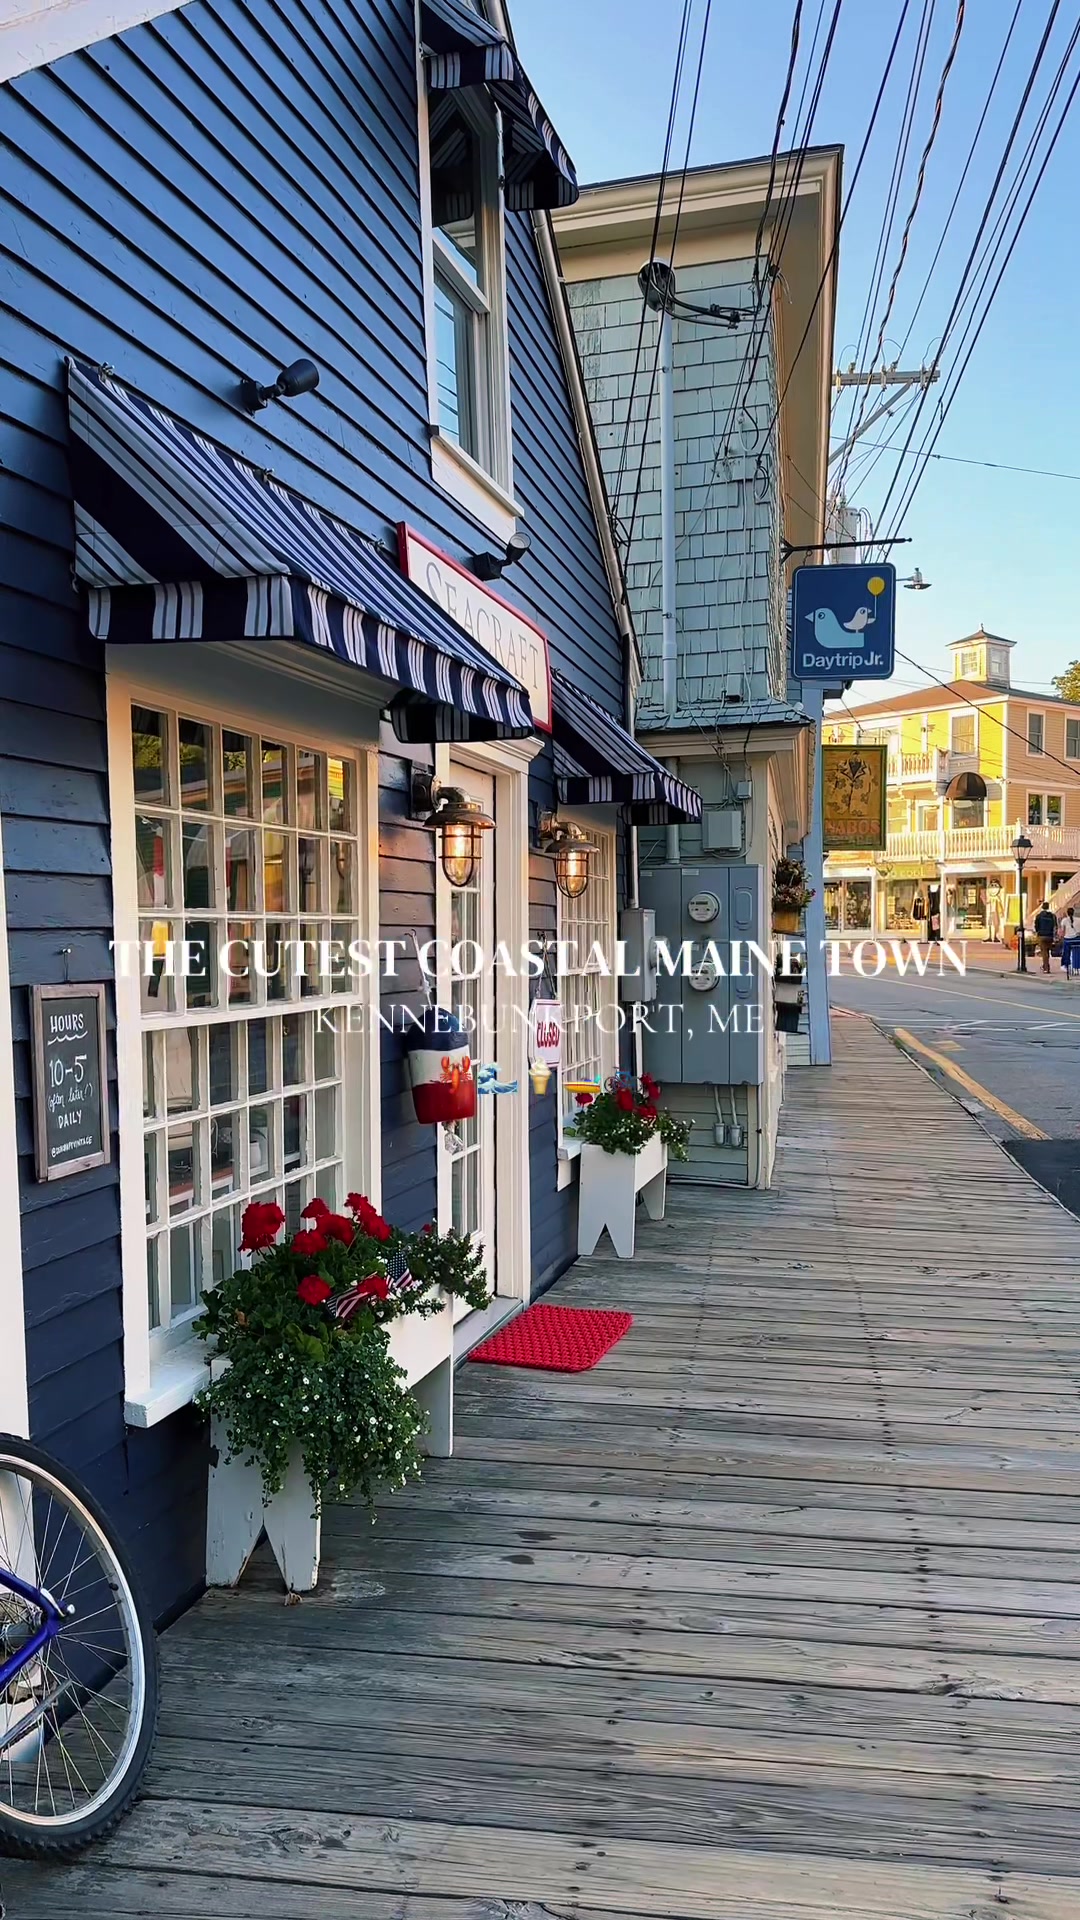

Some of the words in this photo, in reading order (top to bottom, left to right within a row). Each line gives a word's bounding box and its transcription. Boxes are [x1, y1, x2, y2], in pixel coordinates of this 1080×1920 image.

[426, 561, 539, 689] SEACRAFT
[803, 652, 863, 670] Daytrip
[864, 651, 884, 666] Jr.
[50, 1013, 84, 1033] HOURS
[536, 1021, 560, 1048] CLOSED
[49, 1054, 87, 1087] 10-5
[58, 1109, 82, 1129] DAILY
